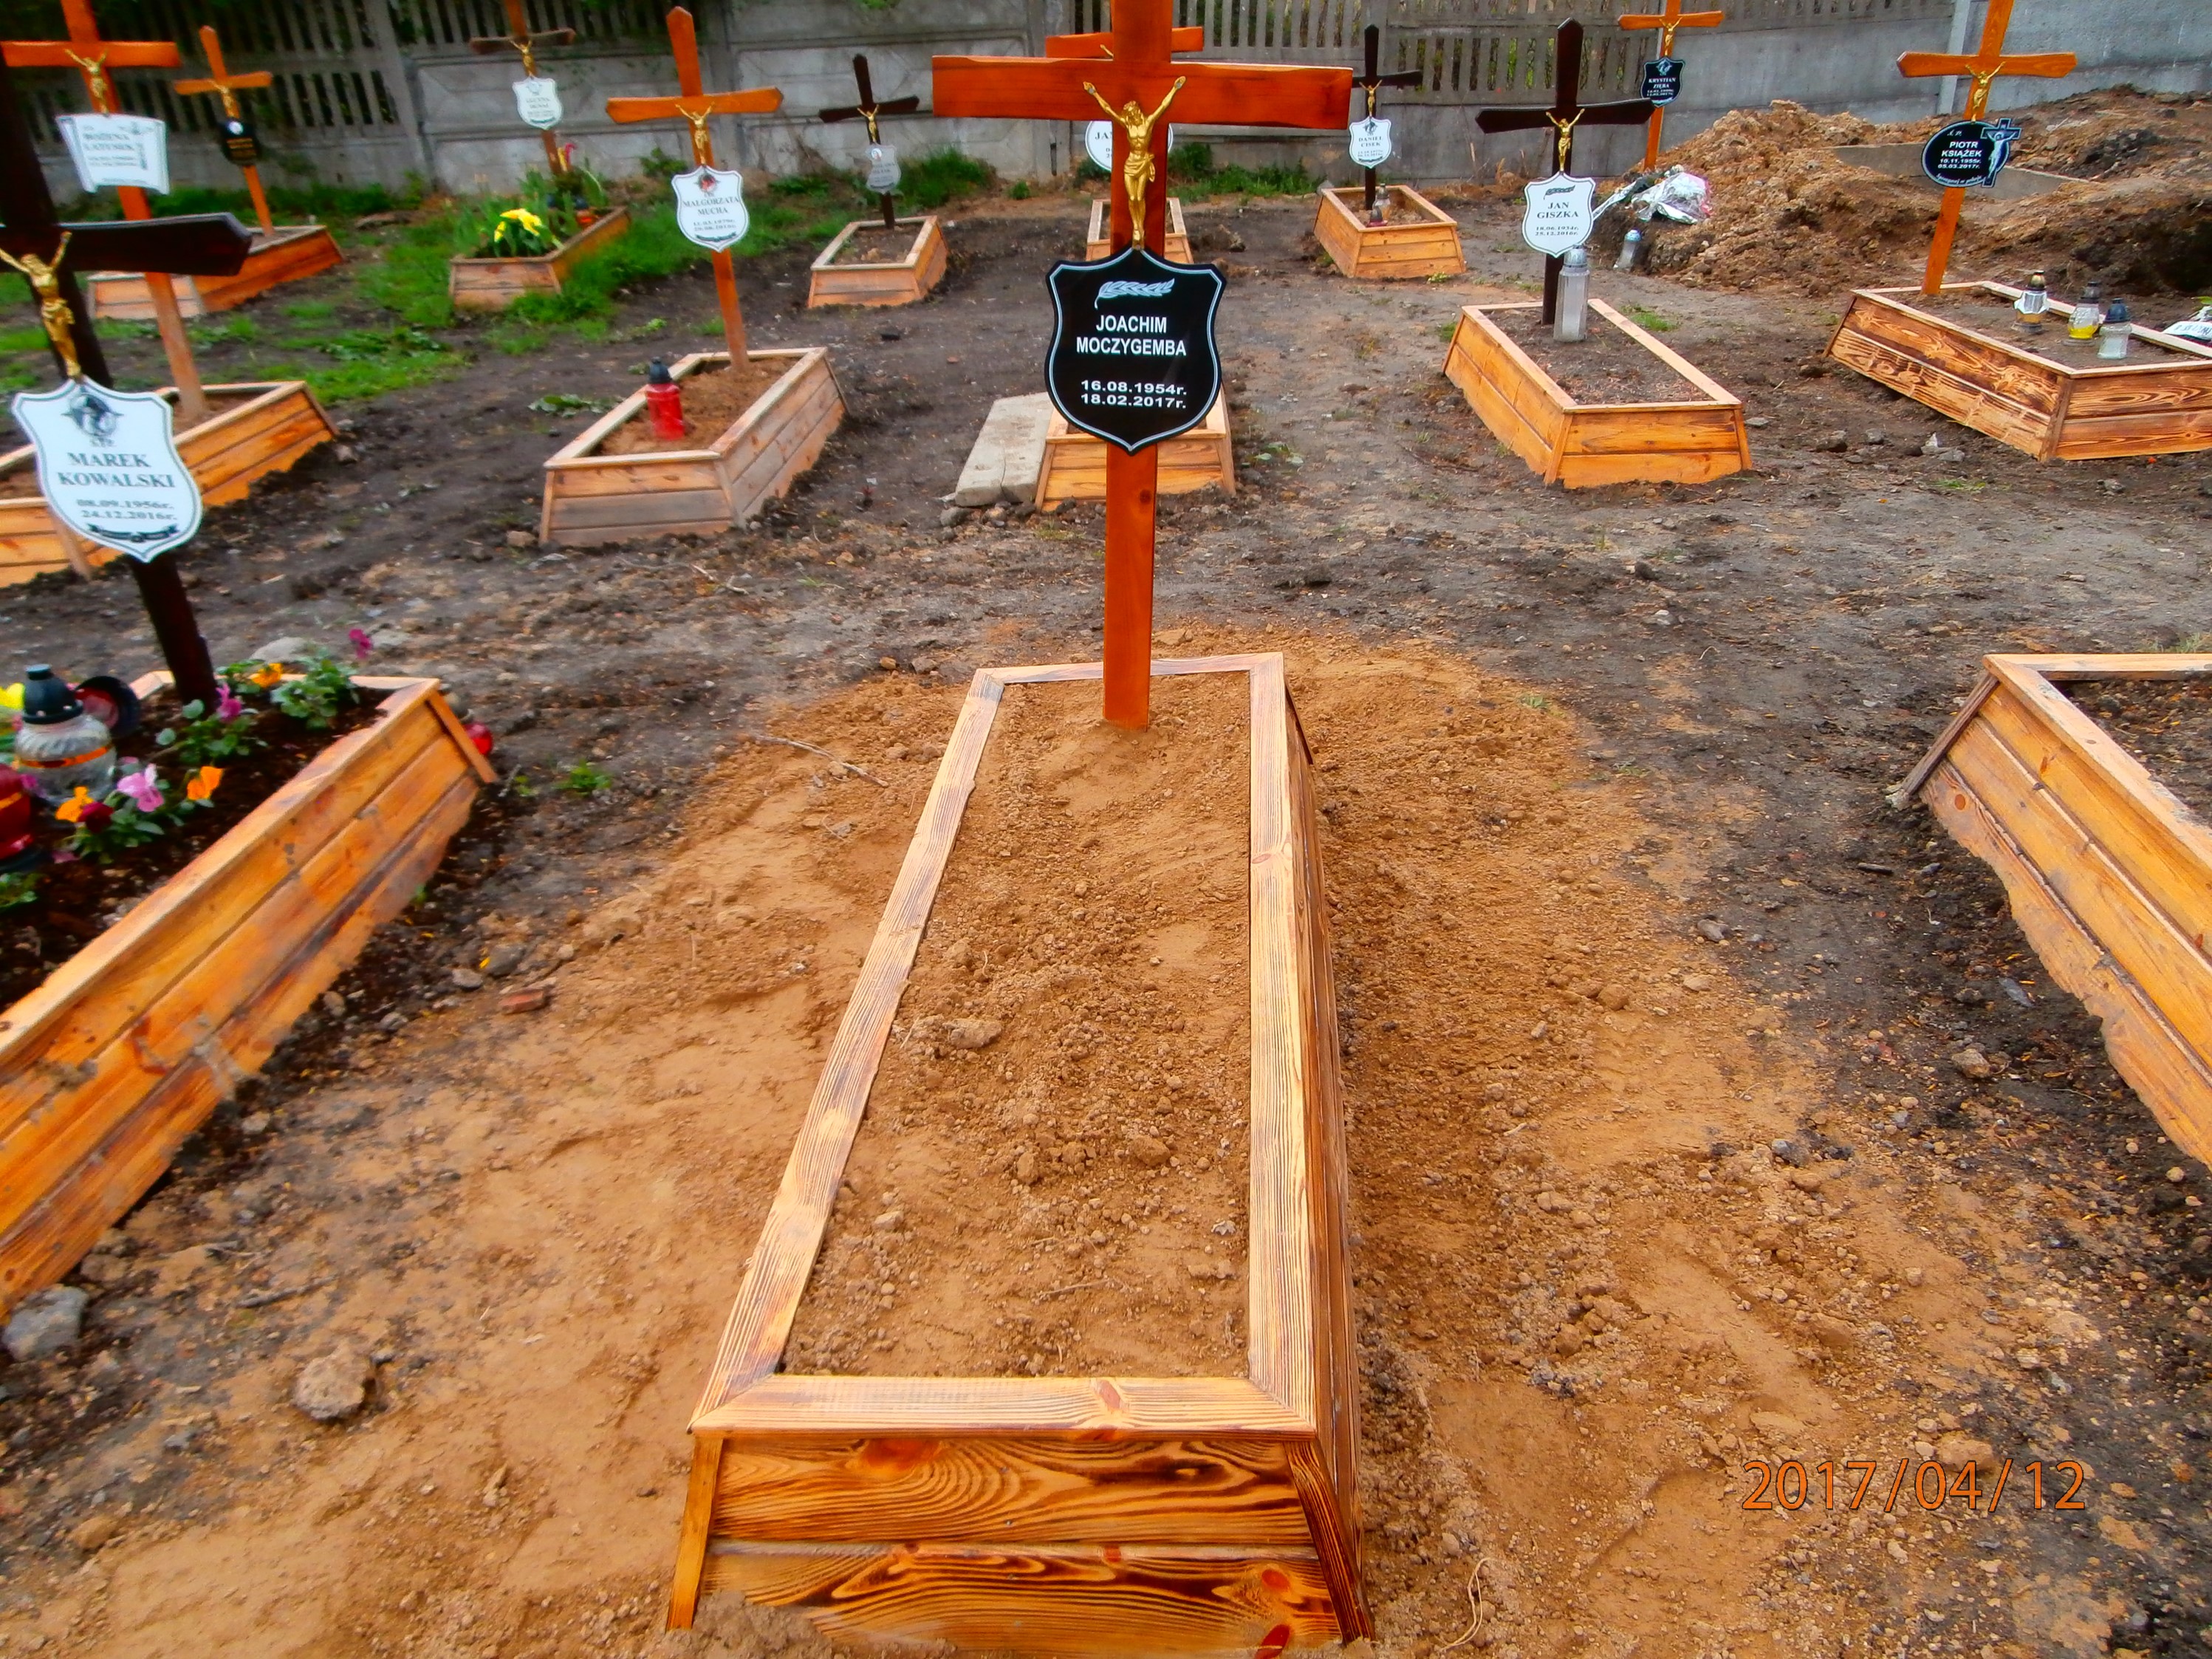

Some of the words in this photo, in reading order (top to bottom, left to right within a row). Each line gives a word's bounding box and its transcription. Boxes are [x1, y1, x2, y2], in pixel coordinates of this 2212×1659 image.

[1095, 131, 1112, 140] JA
[1941, 149, 1982, 159] KSIĄŻEK
[682, 196, 739, 207] MAŁGORZATA
[698, 208, 728, 216] MUCHA
[1096, 315, 1167, 333] JOACHIM
[1076, 337, 1187, 356] MOCZYGEMBA
[1081, 380, 1187, 395] 16.08.1954r.
[1081, 394, 1186, 408] 18.02.2017r.
[67, 452, 151, 468] MAREK
[58, 471, 176, 488] KOWALSKI
